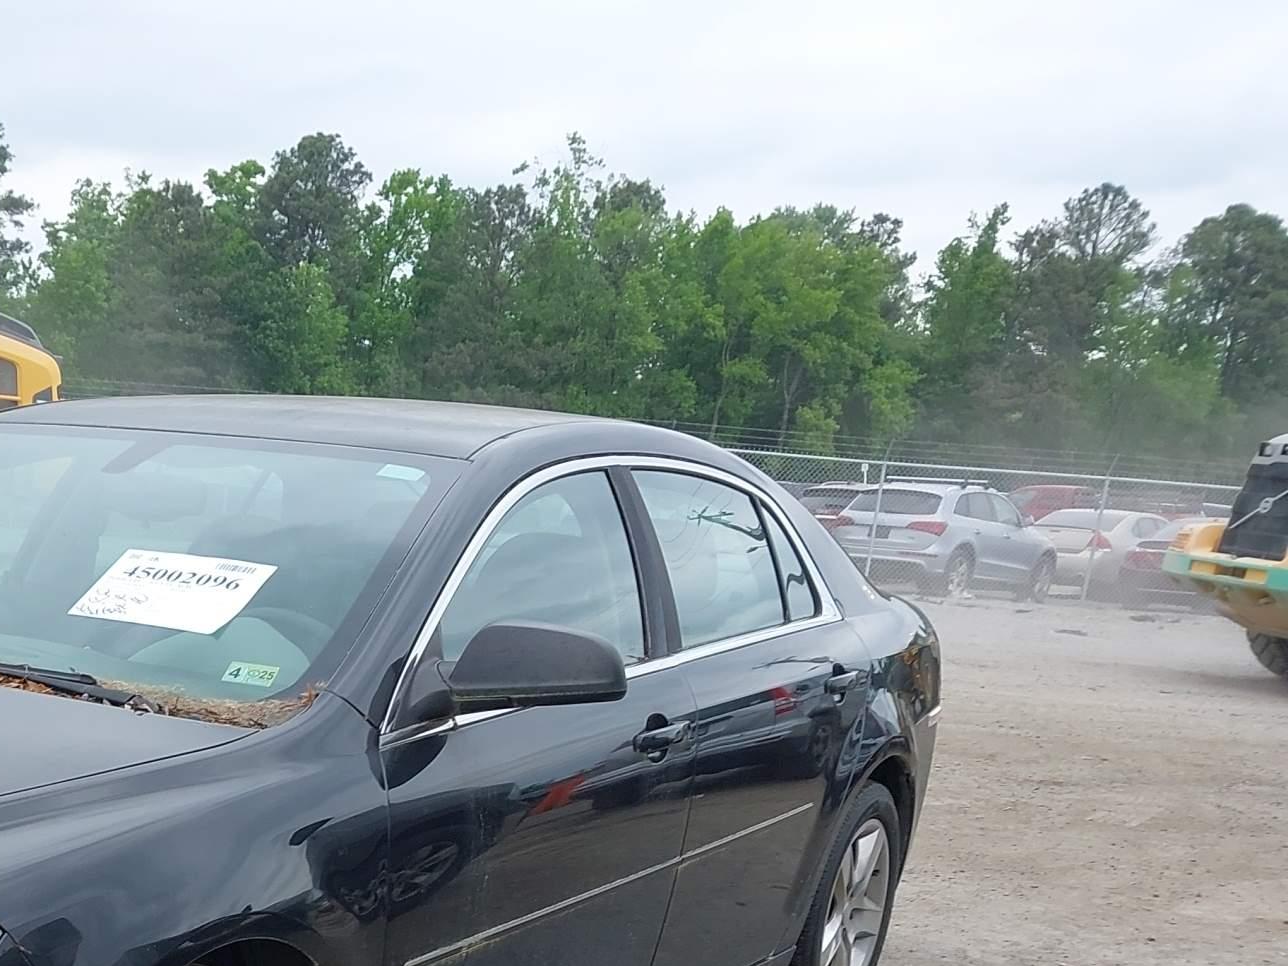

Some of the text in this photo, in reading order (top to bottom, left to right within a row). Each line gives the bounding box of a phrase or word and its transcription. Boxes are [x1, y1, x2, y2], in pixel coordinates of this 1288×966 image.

[123, 565, 244, 592] 45002096
[228, 666, 276, 680] 4 25
